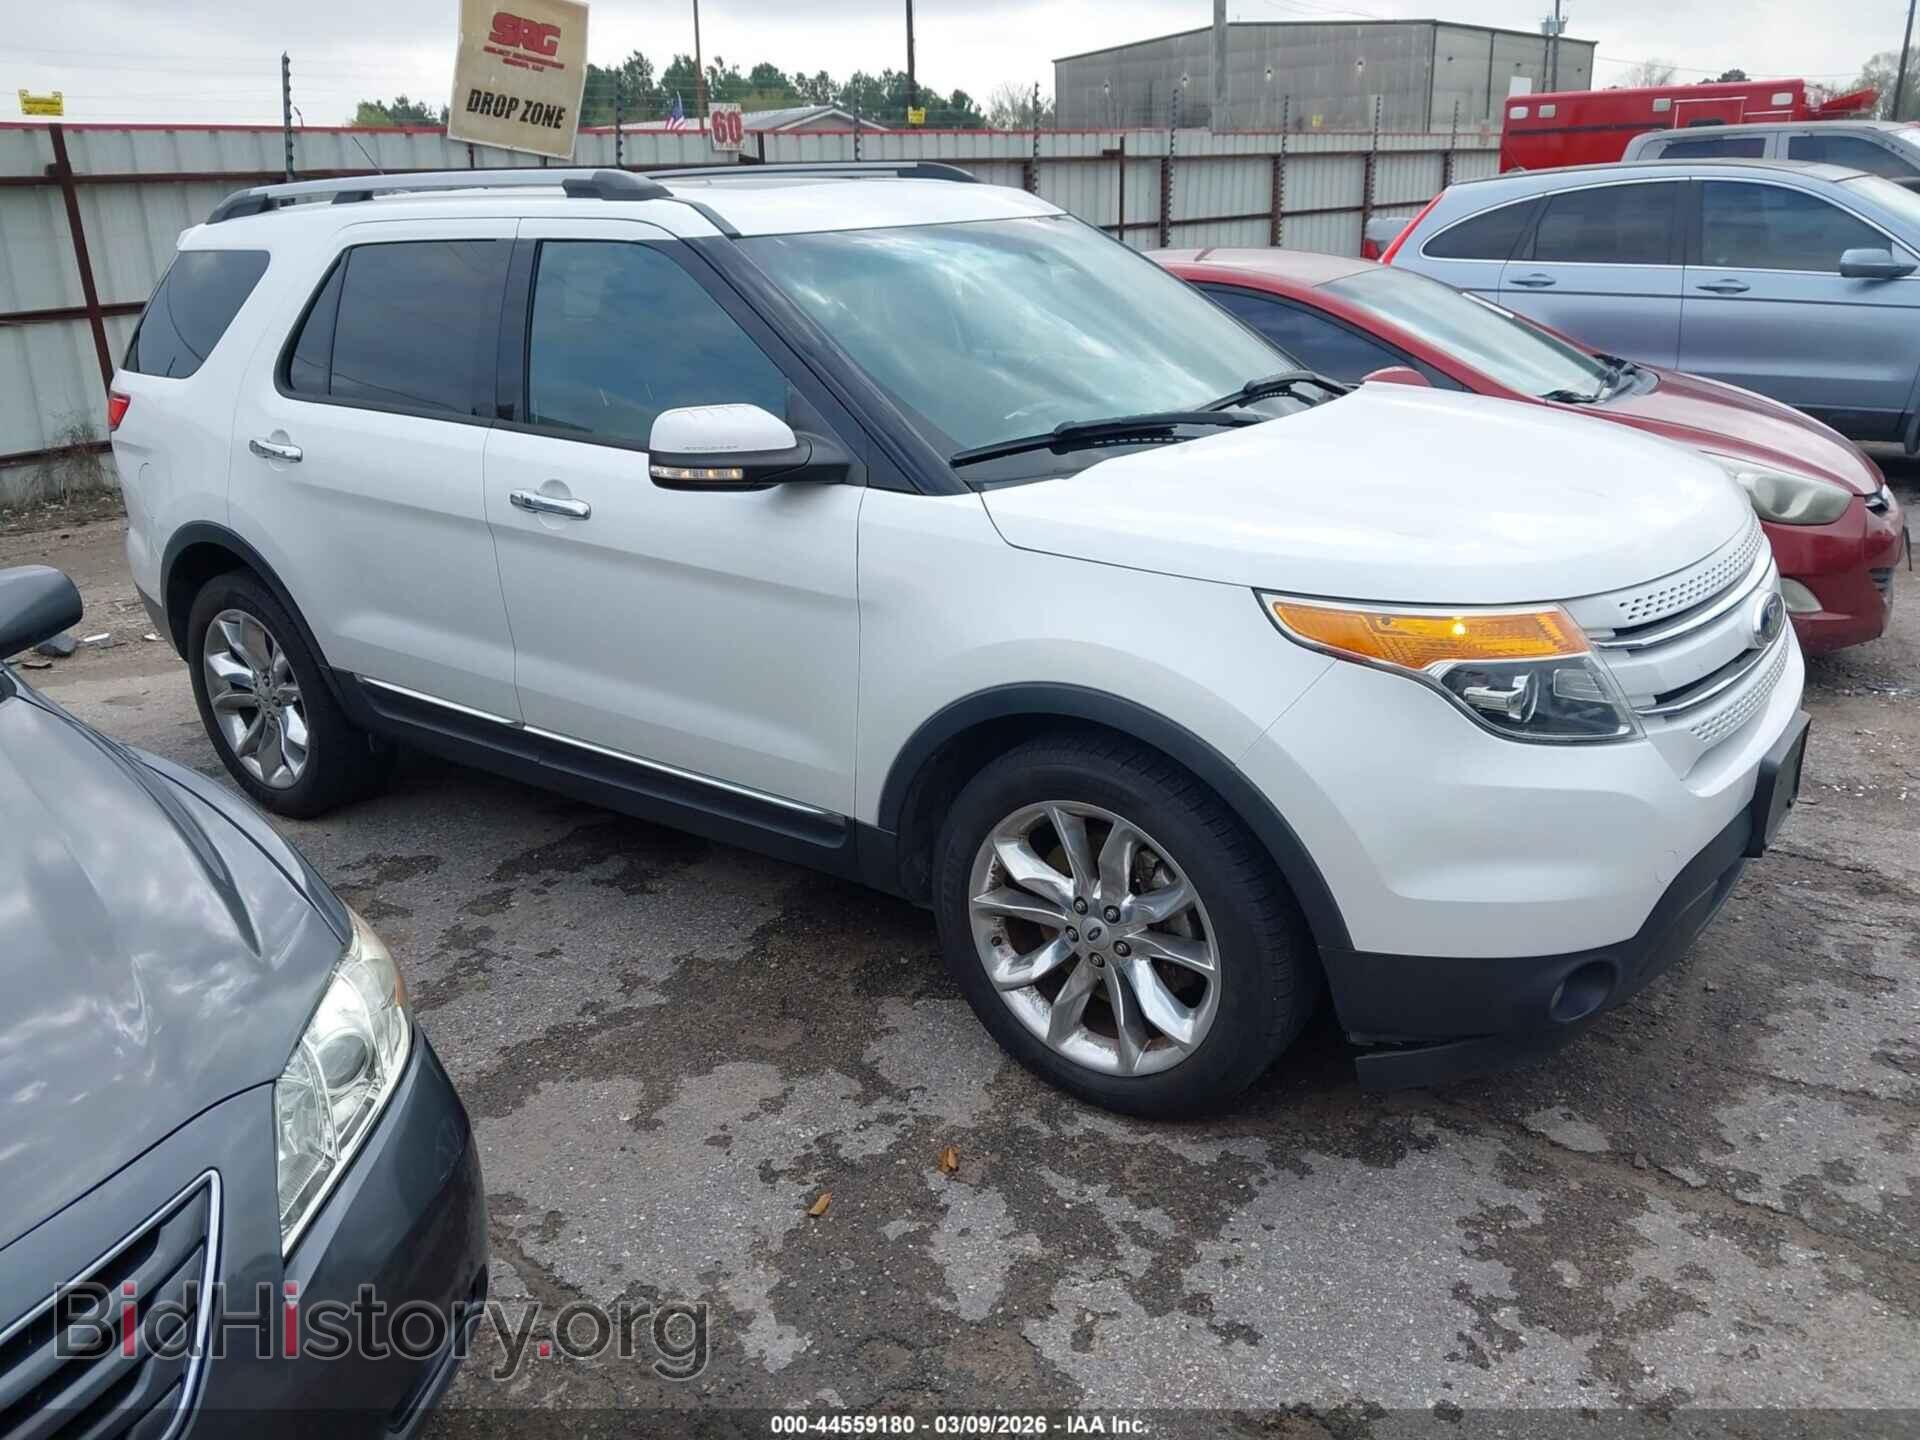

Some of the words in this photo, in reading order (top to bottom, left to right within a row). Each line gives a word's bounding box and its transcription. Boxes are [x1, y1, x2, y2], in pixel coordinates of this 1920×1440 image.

[489, 12, 561, 56] SRG
[466, 89, 519, 120] DROP
[520, 100, 566, 129] ZONE
[712, 111, 741, 144] 60
